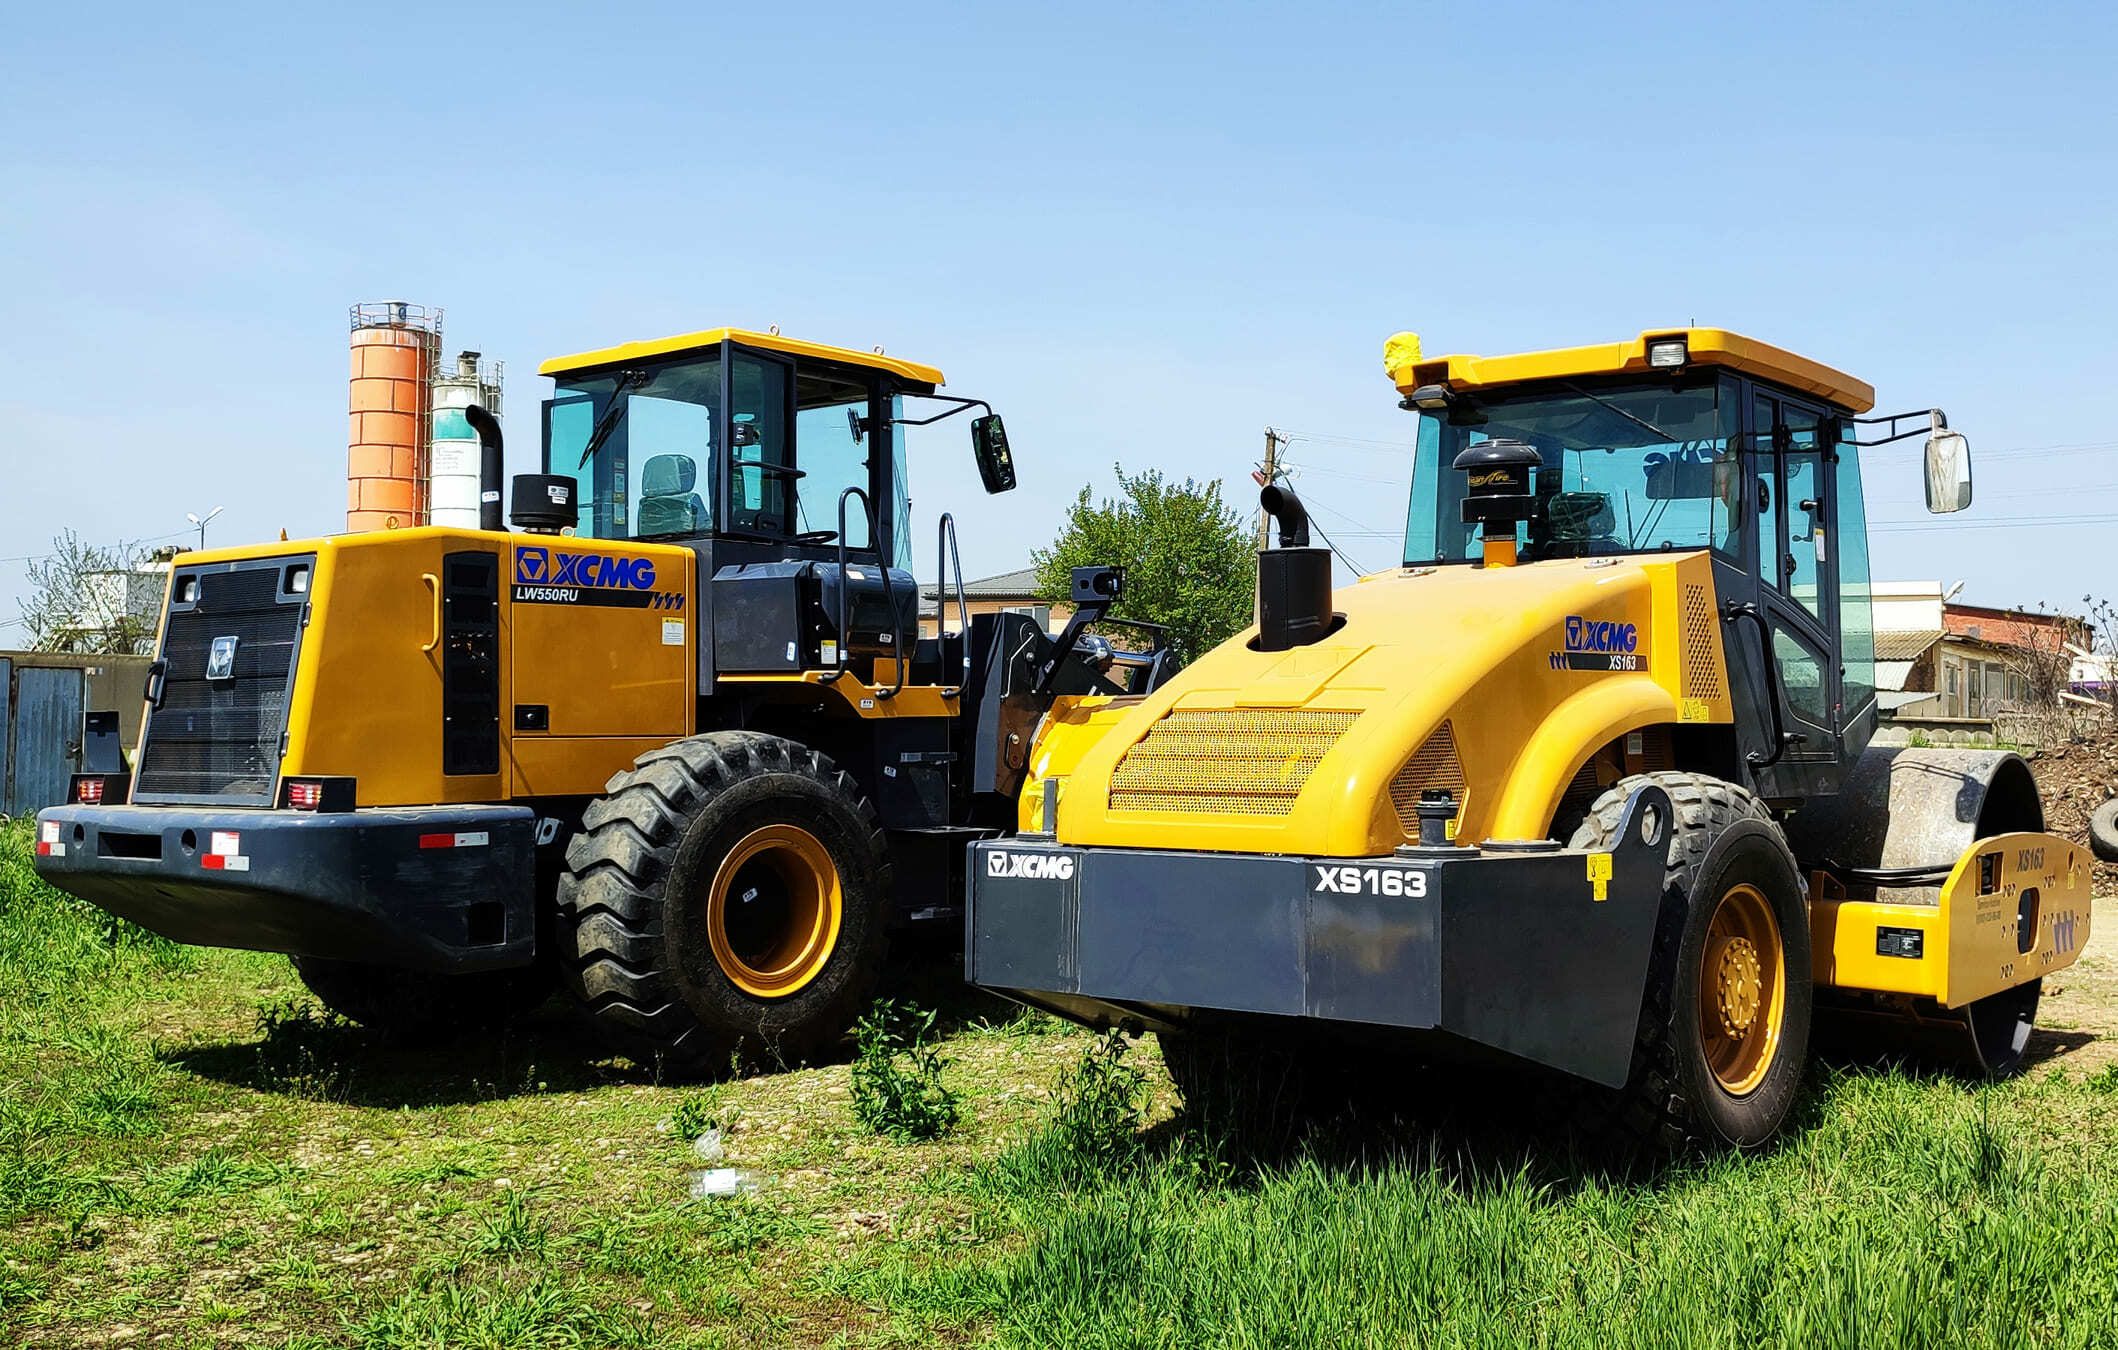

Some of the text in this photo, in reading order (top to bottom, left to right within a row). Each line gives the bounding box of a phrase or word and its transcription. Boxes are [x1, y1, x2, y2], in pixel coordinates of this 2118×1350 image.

[550, 553, 656, 590] XCMG
[516, 586, 579, 602] LW550RU
[1584, 621, 1637, 653] XCMG
[1609, 655, 1636, 671] XS163
[1007, 854, 1074, 880] XCMG
[2016, 847, 2046, 872] XS163
[1315, 865, 1427, 898] XS163
